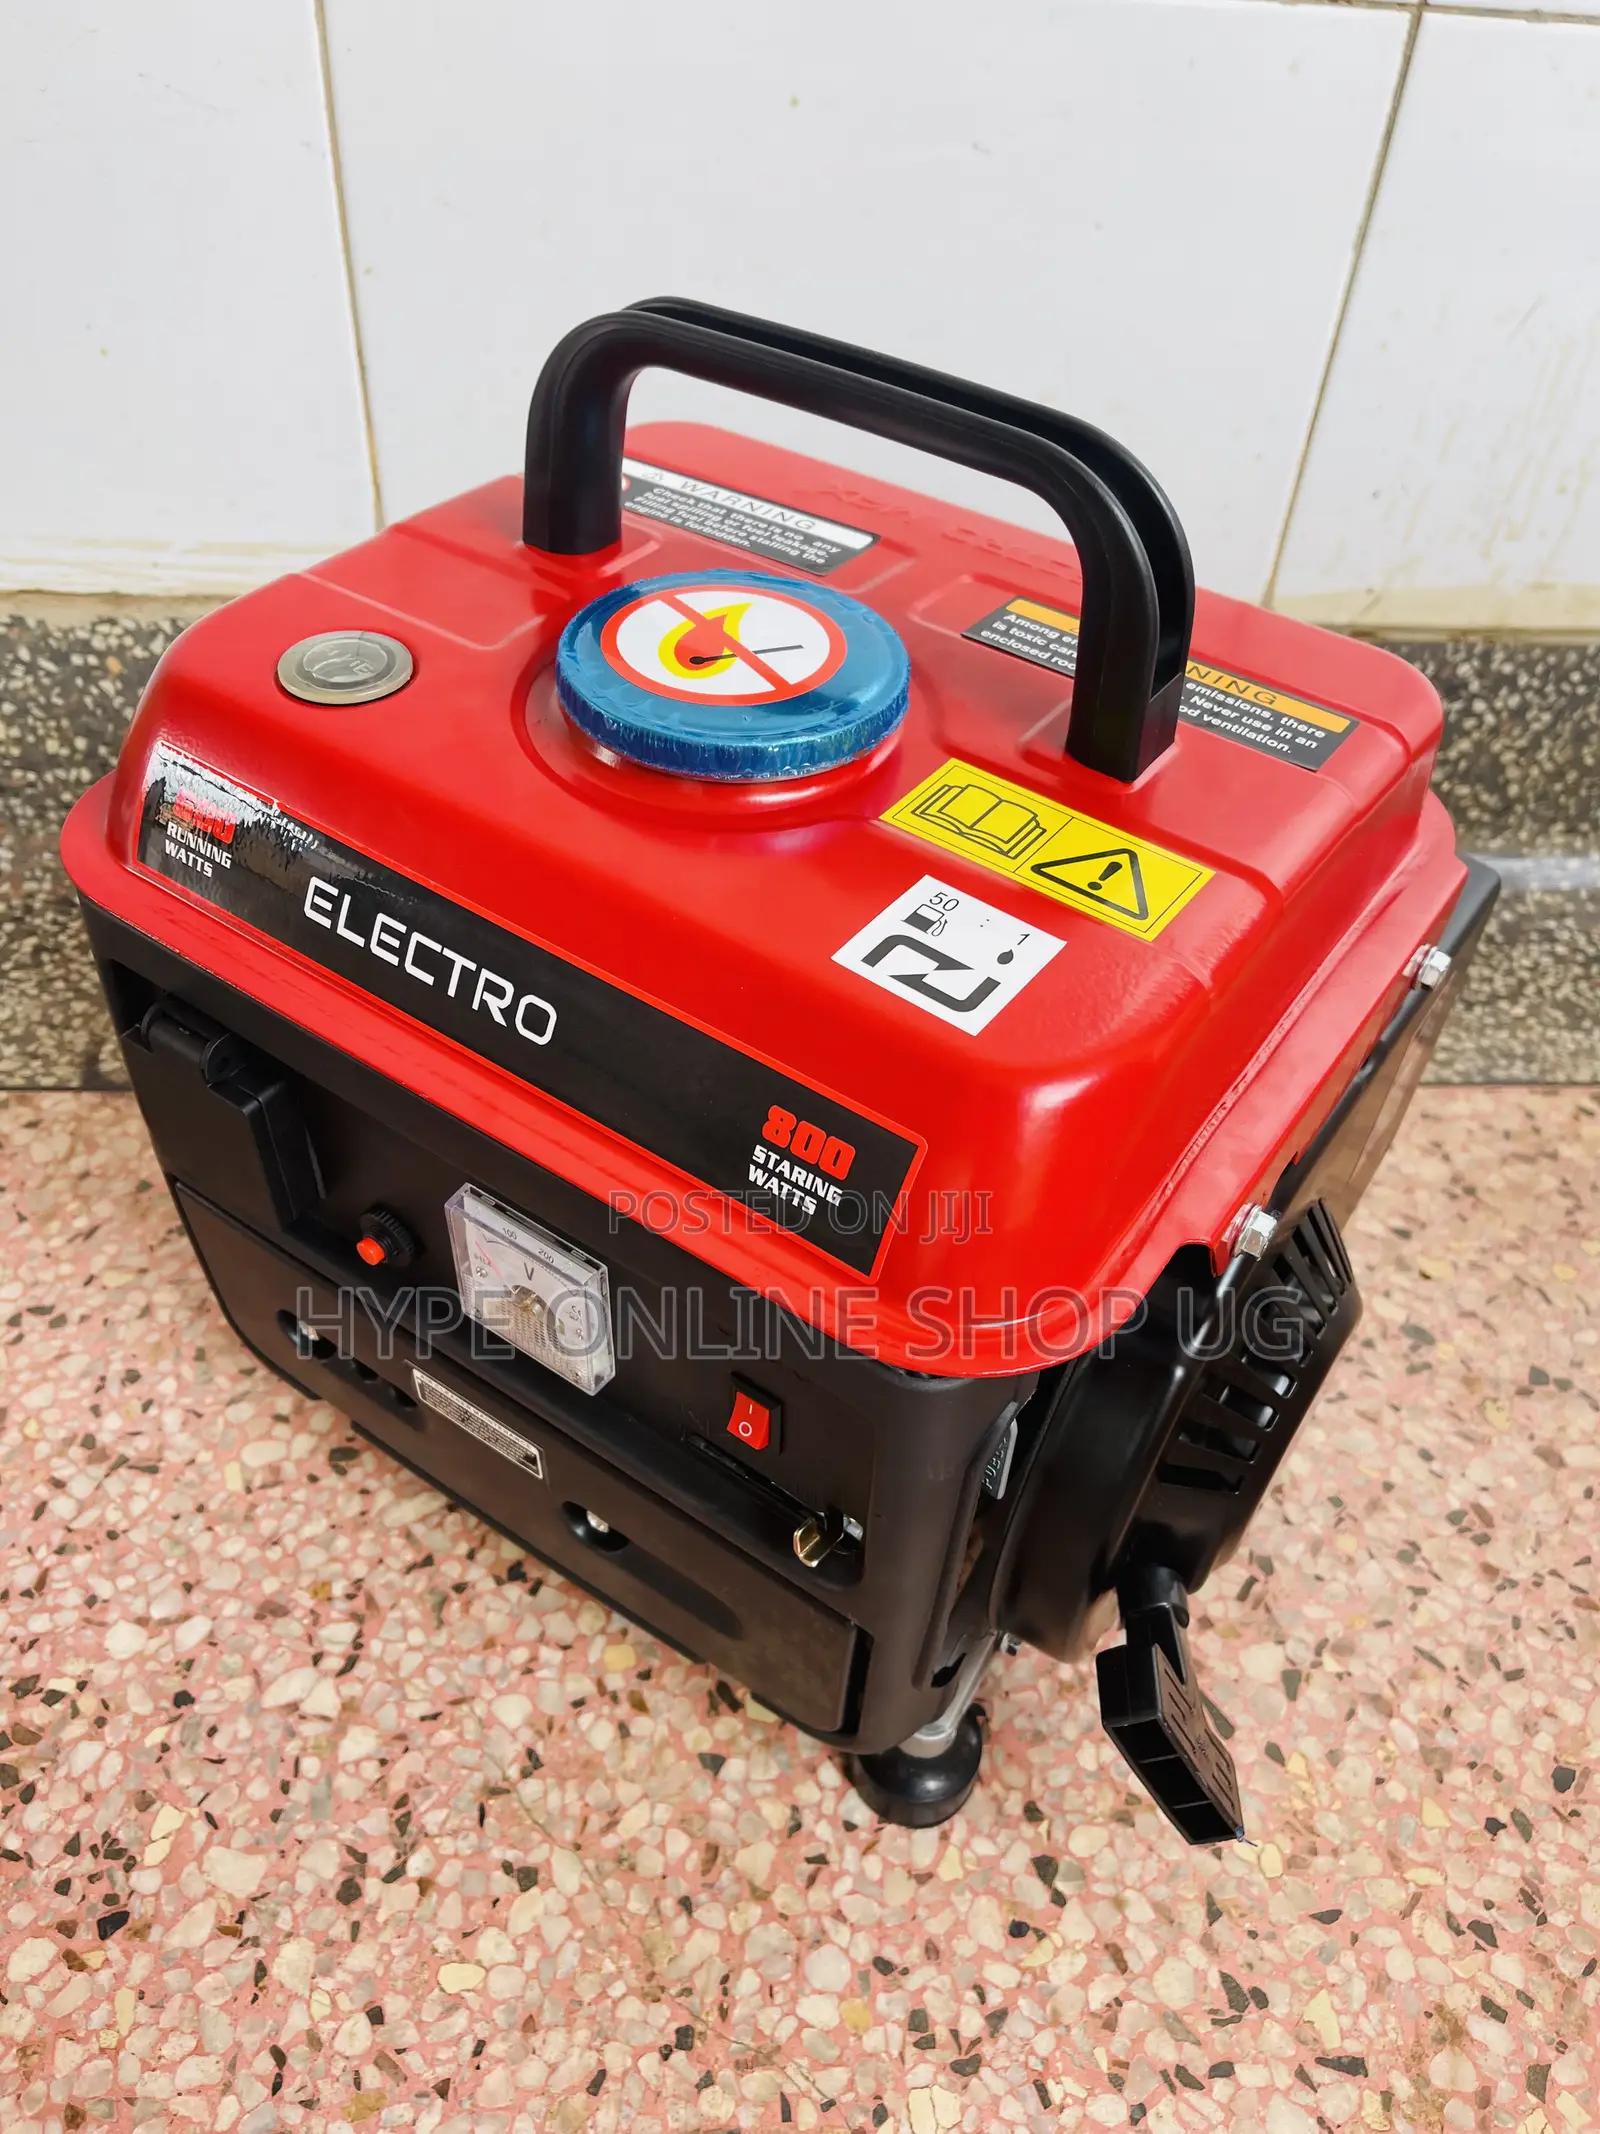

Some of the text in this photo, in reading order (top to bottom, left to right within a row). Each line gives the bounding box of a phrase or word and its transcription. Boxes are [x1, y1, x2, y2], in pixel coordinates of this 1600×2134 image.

[624, 501, 669, 518] engine
[684, 520, 751, 547] forbidden.
[643, 492, 672, 504] fuel
[742, 525, 771, 537] fuel
[653, 488, 695, 505] Check
[697, 501, 727, 515] that
[730, 512, 768, 529] there
[784, 531, 804, 541] no
[812, 541, 842, 554] any
[680, 480, 816, 531] WARNING
[676, 510, 705, 522] fuel
[704, 520, 747, 537] before
[802, 553, 826, 565] the
[980, 630, 1051, 660] enclosed
[1051, 656, 1076, 670] roo
[1179, 705, 1201, 717] od
[1203, 713, 1291, 754] ventilation.
[992, 621, 1008, 631] is
[1008, 627, 1047, 646] toxic
[1190, 695, 1240, 719] Never
[1241, 716, 1273, 732] use
[1275, 727, 1293, 740] in
[1295, 736, 1318, 750] an
[1003, 614, 1326, 739] Among emissions, there
[1187, 665, 1276, 706] NING
[165, 839, 213, 878] WATTS
[166, 821, 232, 869] RUNNING
[929, 891, 960, 912] 50
[1017, 933, 1030, 946] 1
[303, 875, 558, 1047] ELECTRO
[761, 1104, 856, 1181] 800
[748, 1164, 818, 1216] WATTS
[752, 1144, 843, 1207] STARING
[502, 1227, 555, 1265] 100 200
[523, 1261, 535, 1282] V
